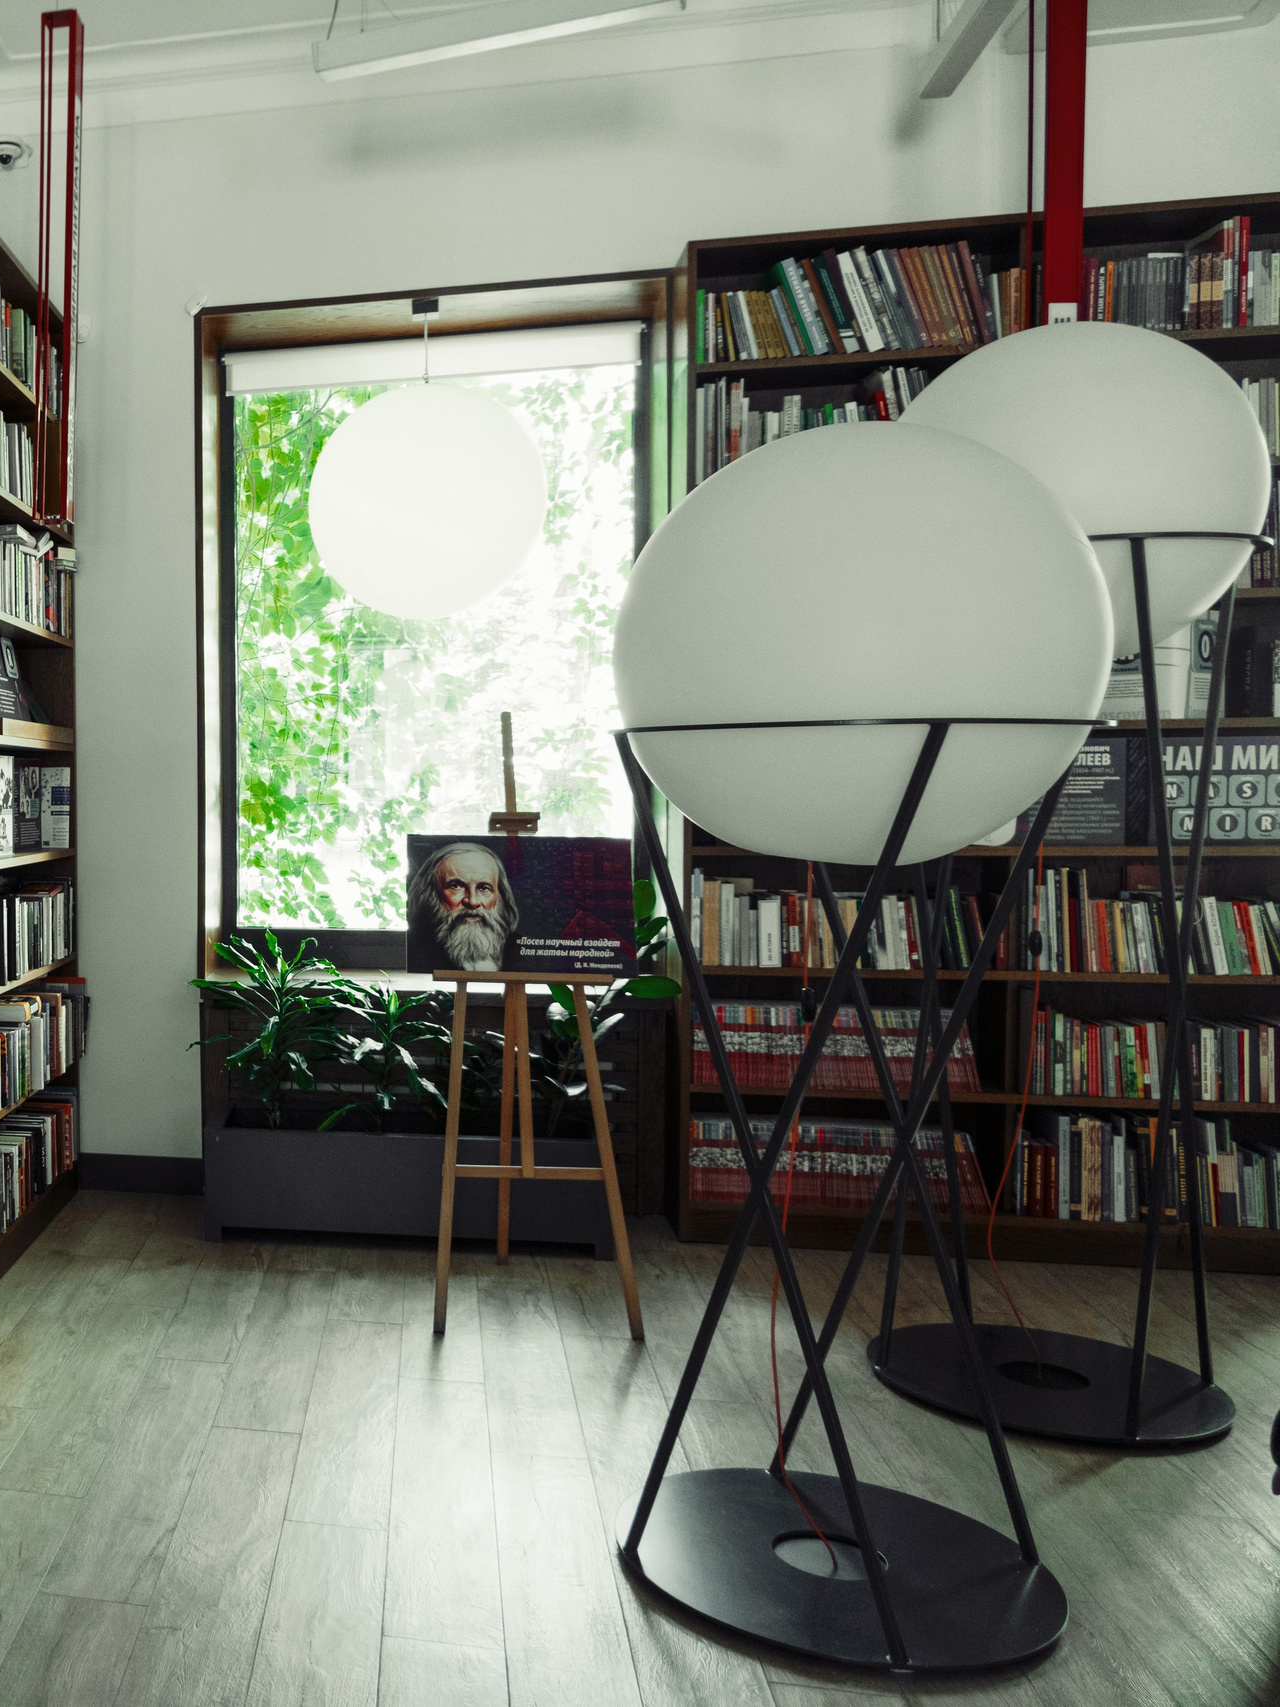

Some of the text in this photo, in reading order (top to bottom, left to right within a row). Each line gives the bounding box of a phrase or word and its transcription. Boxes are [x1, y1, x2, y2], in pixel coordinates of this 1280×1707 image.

[1074, 753, 1111, 766] ЛЕЕВ
[1231, 744, 1280, 771] МИ
[516, 936, 620, 949] «Посев научный взойдет
[520, 948, 615, 959] для жатвы народной»
[589, 962, 623, 970] Менделеев)
